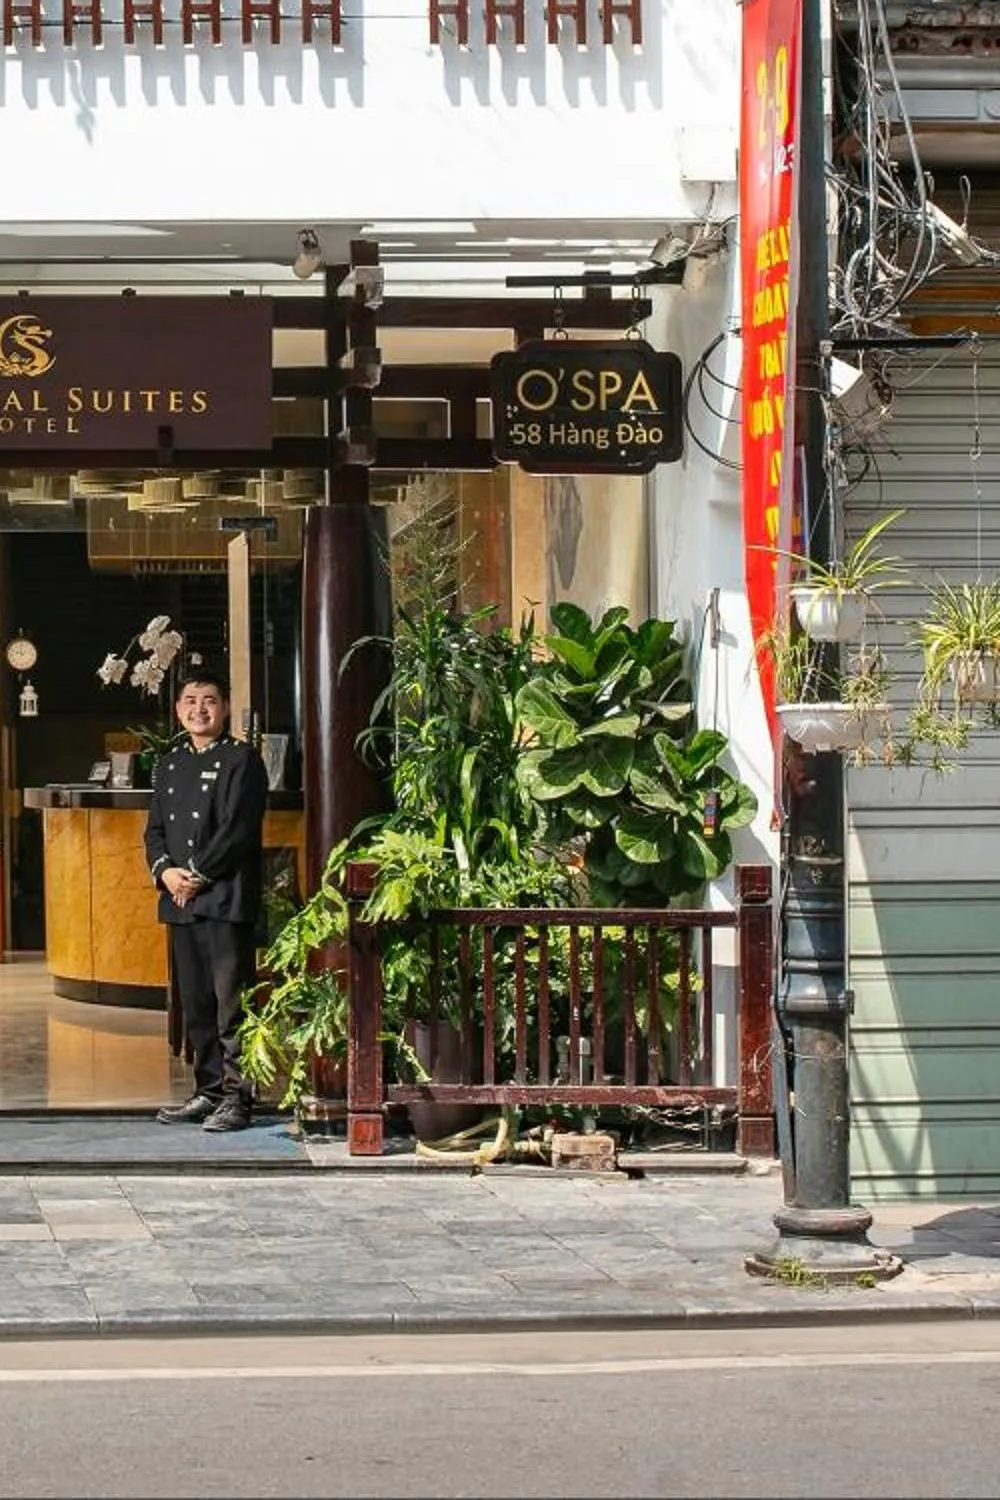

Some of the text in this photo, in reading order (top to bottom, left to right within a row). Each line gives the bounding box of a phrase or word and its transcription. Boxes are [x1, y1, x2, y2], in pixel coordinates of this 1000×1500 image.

[66, 386, 209, 414] SUITES
[512, 421, 664, 449] 58 Hàng Đào
